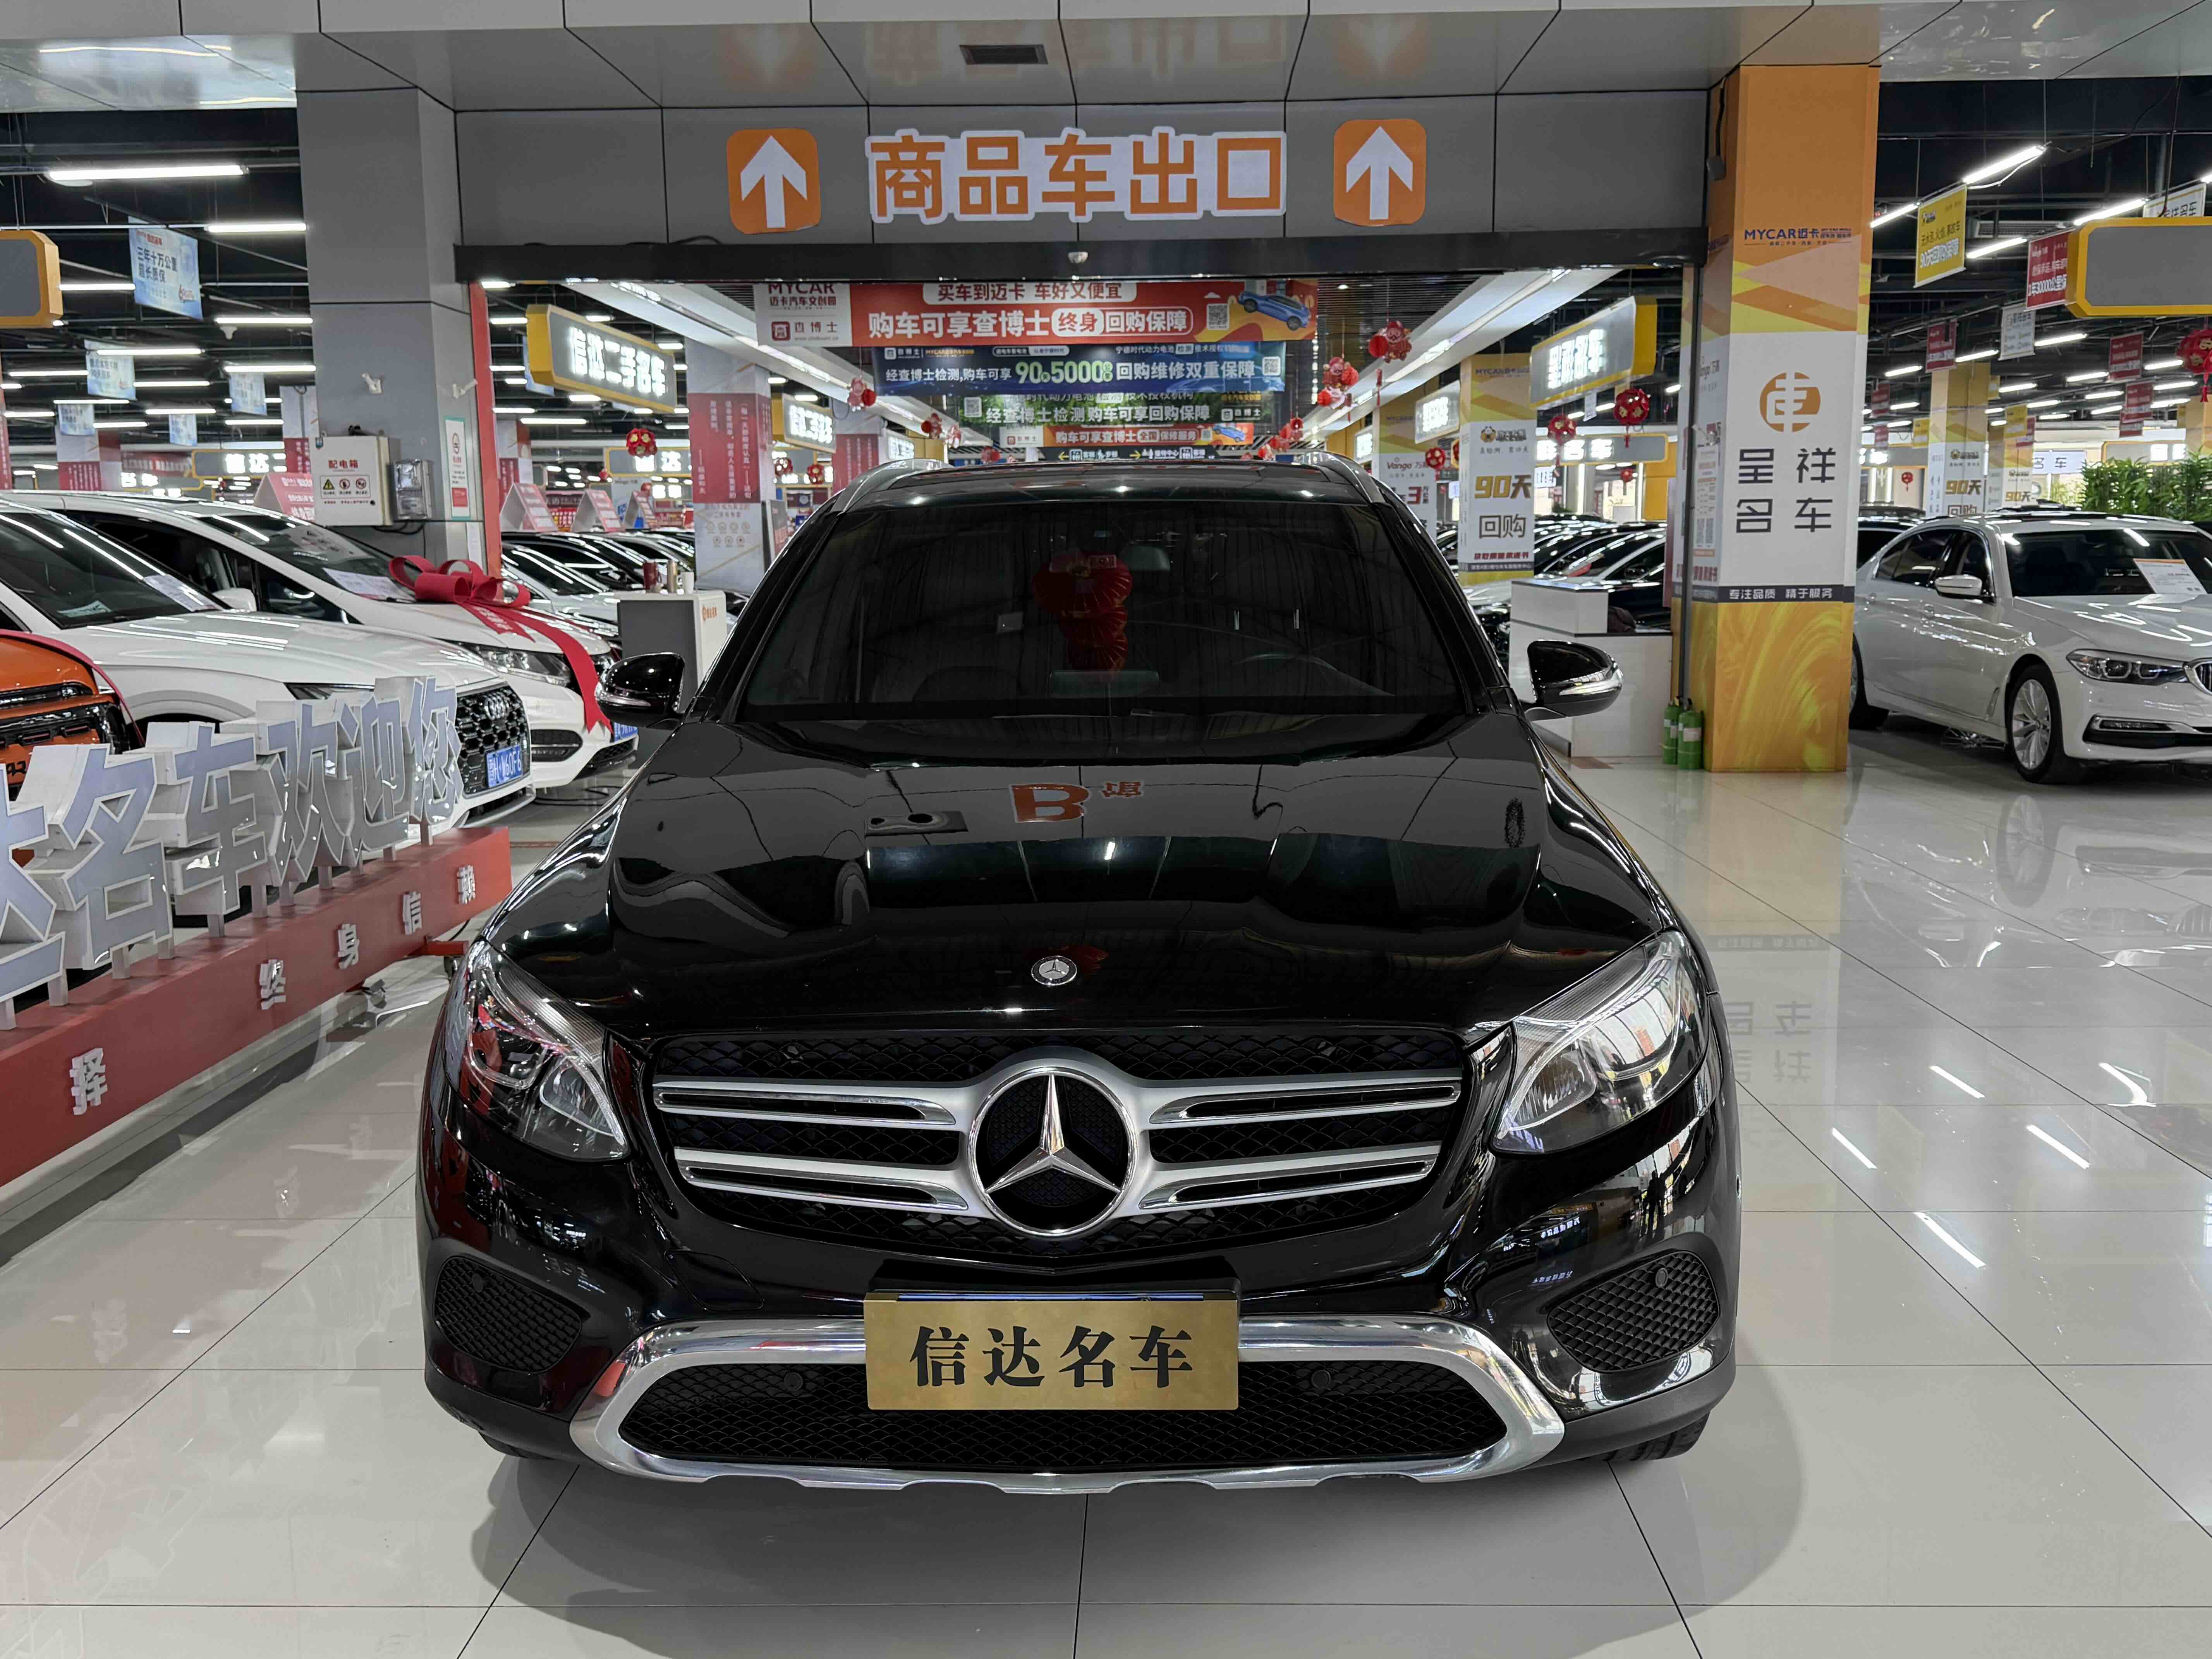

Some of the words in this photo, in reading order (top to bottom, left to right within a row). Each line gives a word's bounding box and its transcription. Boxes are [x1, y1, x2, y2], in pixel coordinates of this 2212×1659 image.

[871, 132, 1282, 218] 商品车出口
[768, 284, 835, 294] MYCAR
[938, 283, 1025, 301] 买车到迈卡
[1034, 282, 1122, 299] 车好又便宜
[328, 459, 359, 469] 配电箱
[1738, 448, 1836, 484] 呈祥
[1474, 474, 1532, 499] 90天
[1946, 480, 1982, 495] 90天
[2005, 491, 2031, 502] 90天
[1479, 514, 1526, 539] 回购
[1736, 497, 1833, 534] 名车
[1729, 588, 1776, 600] 专注品质
[1785, 588, 1833, 599] 精于服务
[909, 1325, 1193, 1388] 信达名车
